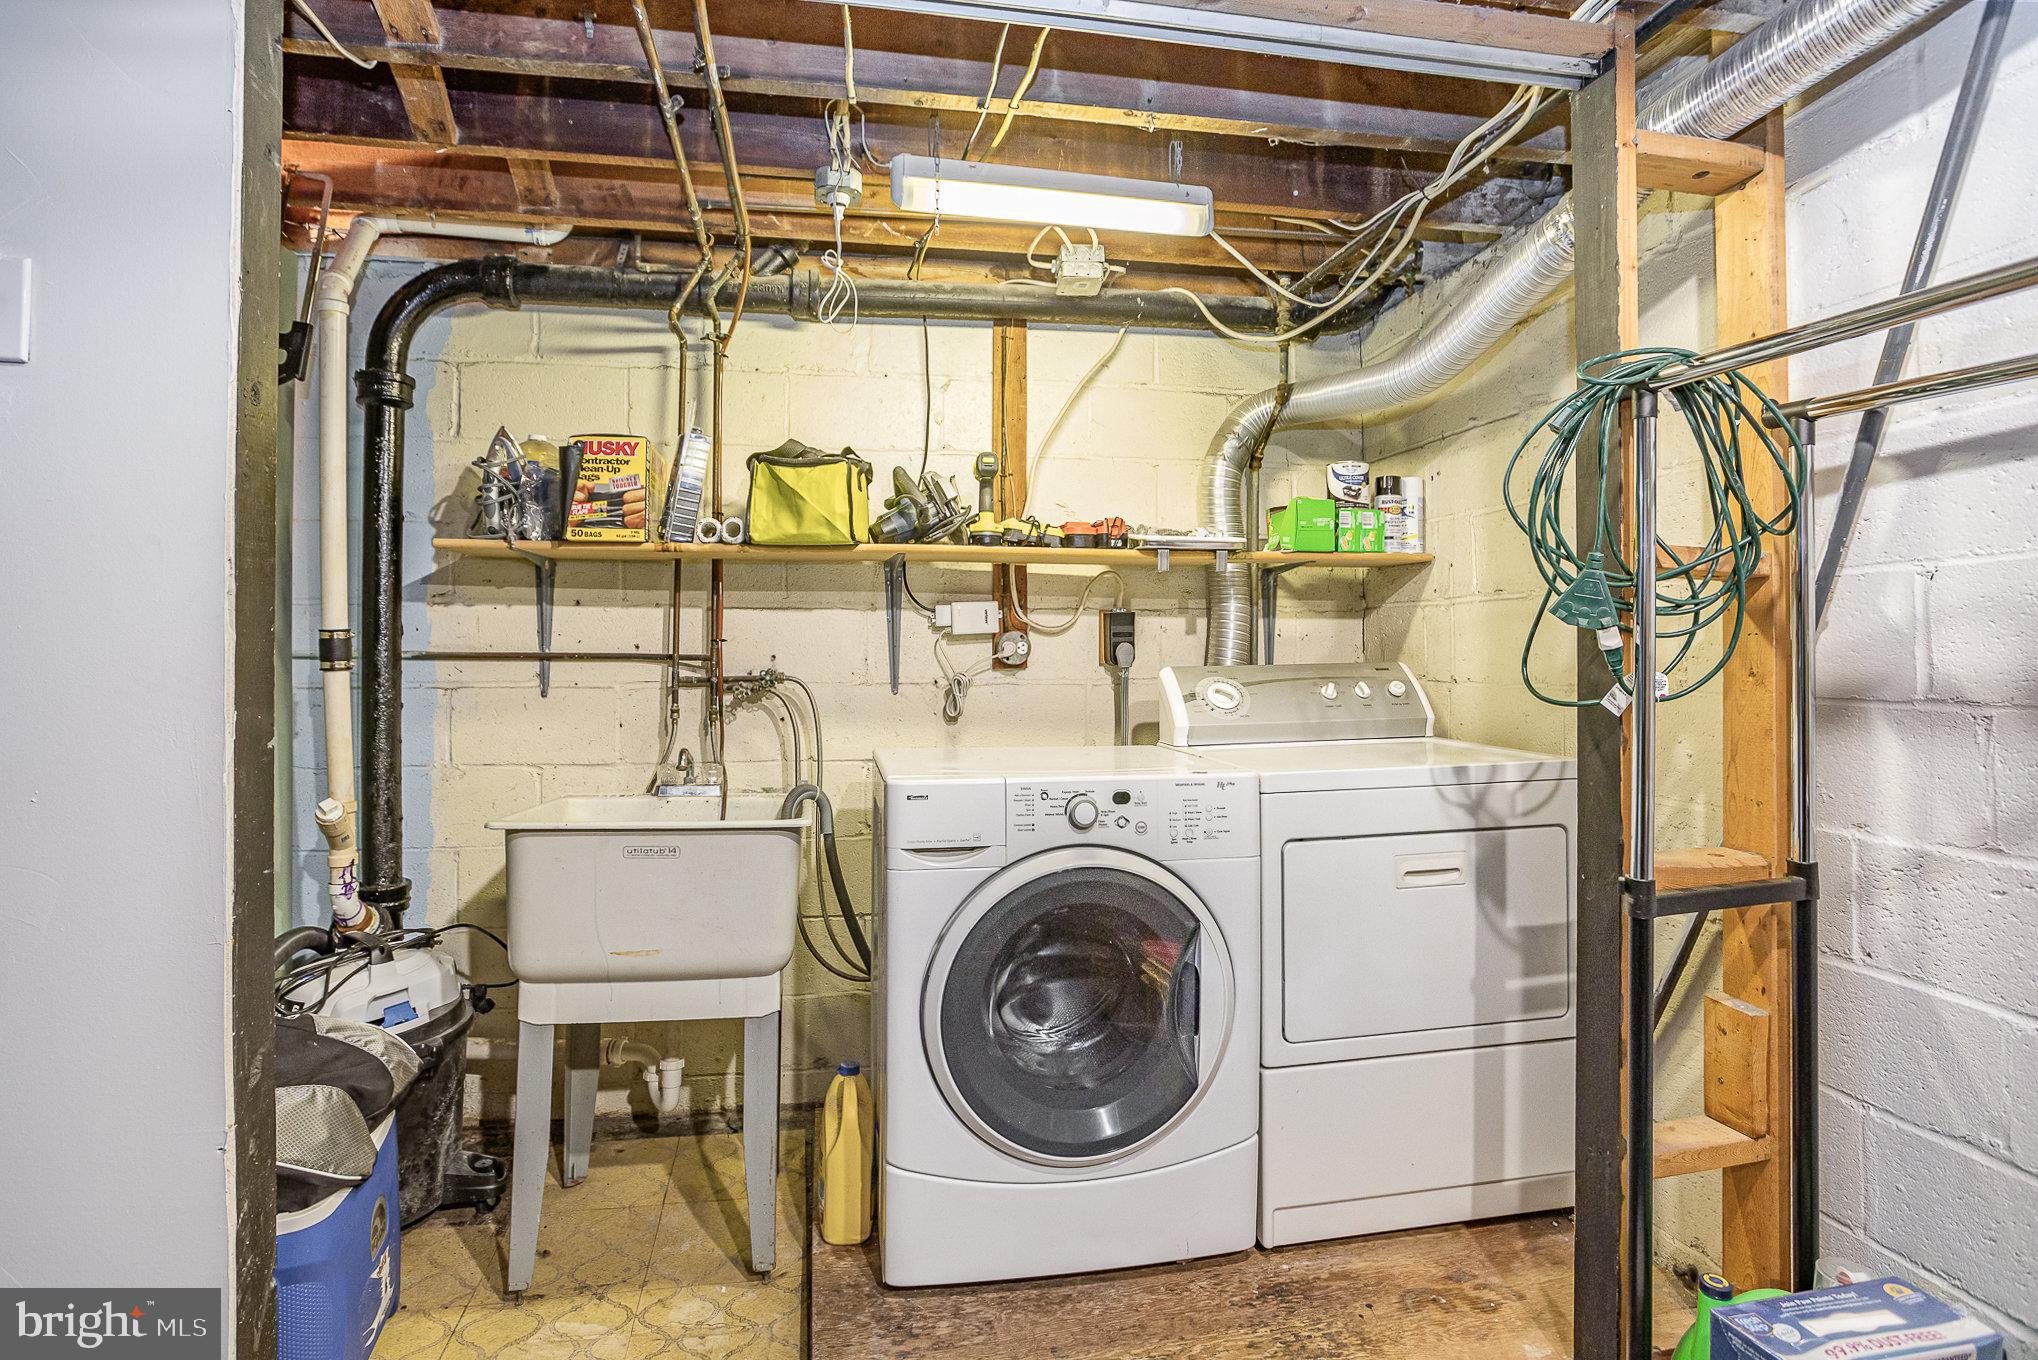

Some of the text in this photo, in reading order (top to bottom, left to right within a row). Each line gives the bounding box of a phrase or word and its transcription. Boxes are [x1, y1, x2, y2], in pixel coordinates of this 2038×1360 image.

[581, 457, 630, 466] ontractor
[580, 465, 621, 474] lean-Up
[577, 473, 601, 482] ags
[571, 529, 584, 538] 50
